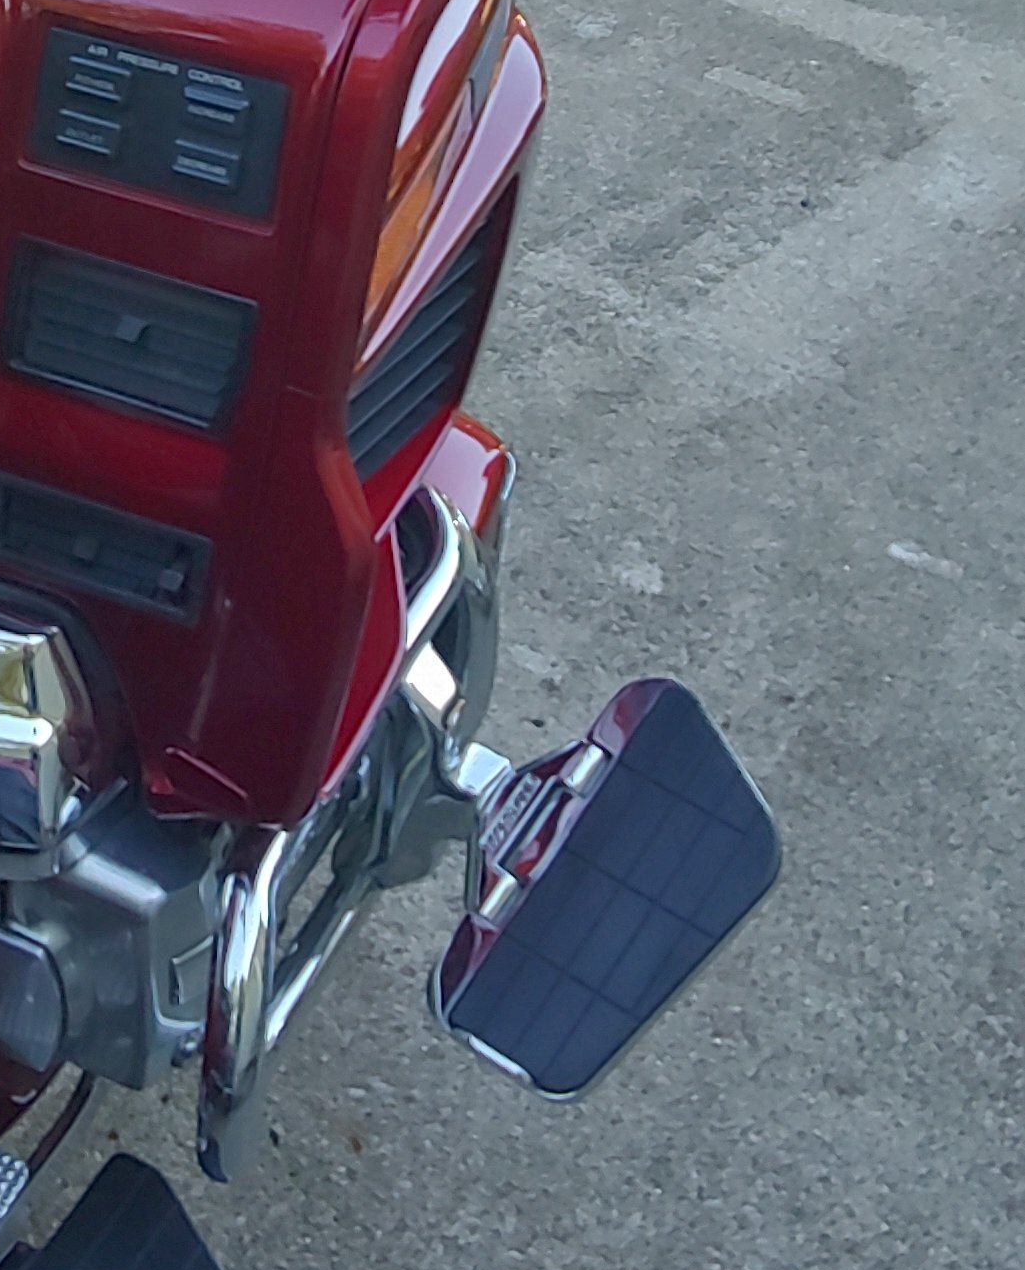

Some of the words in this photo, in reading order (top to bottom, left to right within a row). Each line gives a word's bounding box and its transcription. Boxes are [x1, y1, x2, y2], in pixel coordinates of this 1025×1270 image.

[87, 44, 108, 57] AIR
[117, 51, 179, 75] PRESSURE
[188, 68, 243, 91] CONTROL
